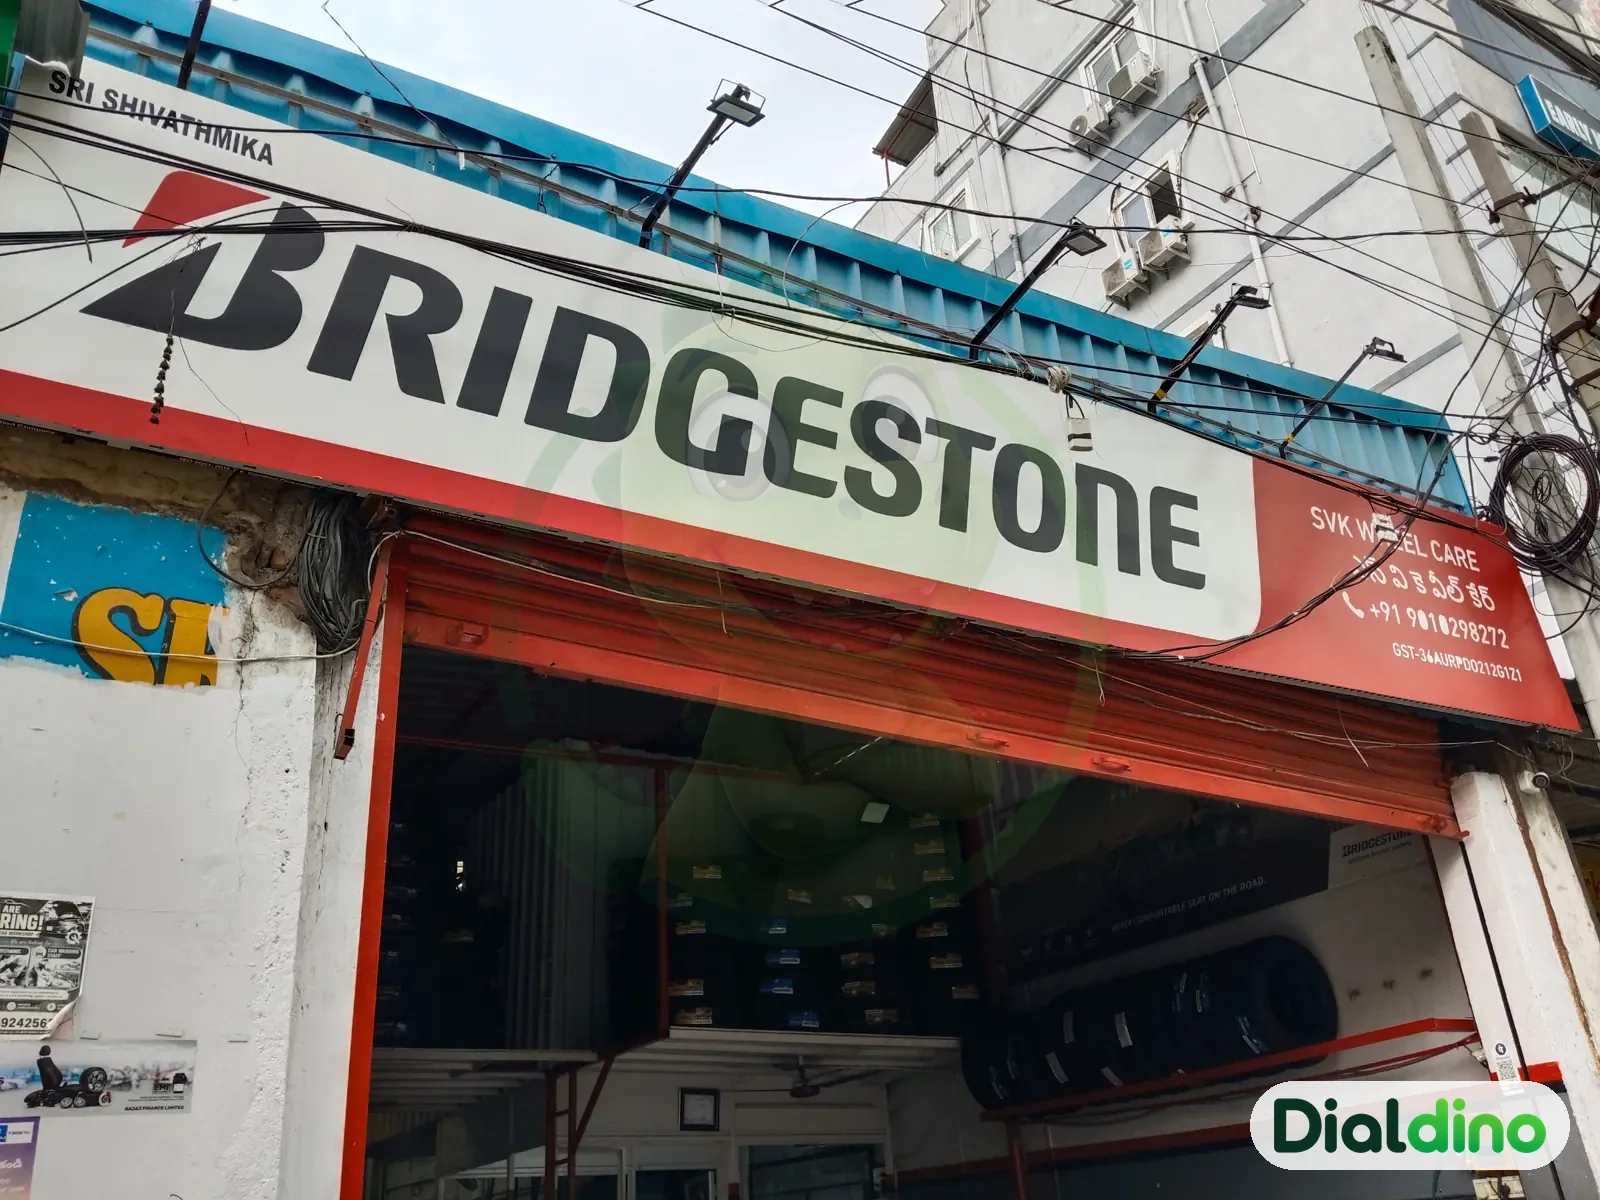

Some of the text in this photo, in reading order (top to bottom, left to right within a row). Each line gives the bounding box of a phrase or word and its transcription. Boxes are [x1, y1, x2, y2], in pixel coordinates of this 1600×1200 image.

[49, 70, 274, 166] SRI SHIVATHMIKA
[79, 171, 1207, 590] BRIDGESTONE
[1310, 506, 1353, 538] SVK
[1430, 539, 1480, 572] CARE
[1370, 600, 1510, 649] +91 9010298272
[2, 905, 21, 914] ARE
[1, 1017, 53, 1028] 924256
